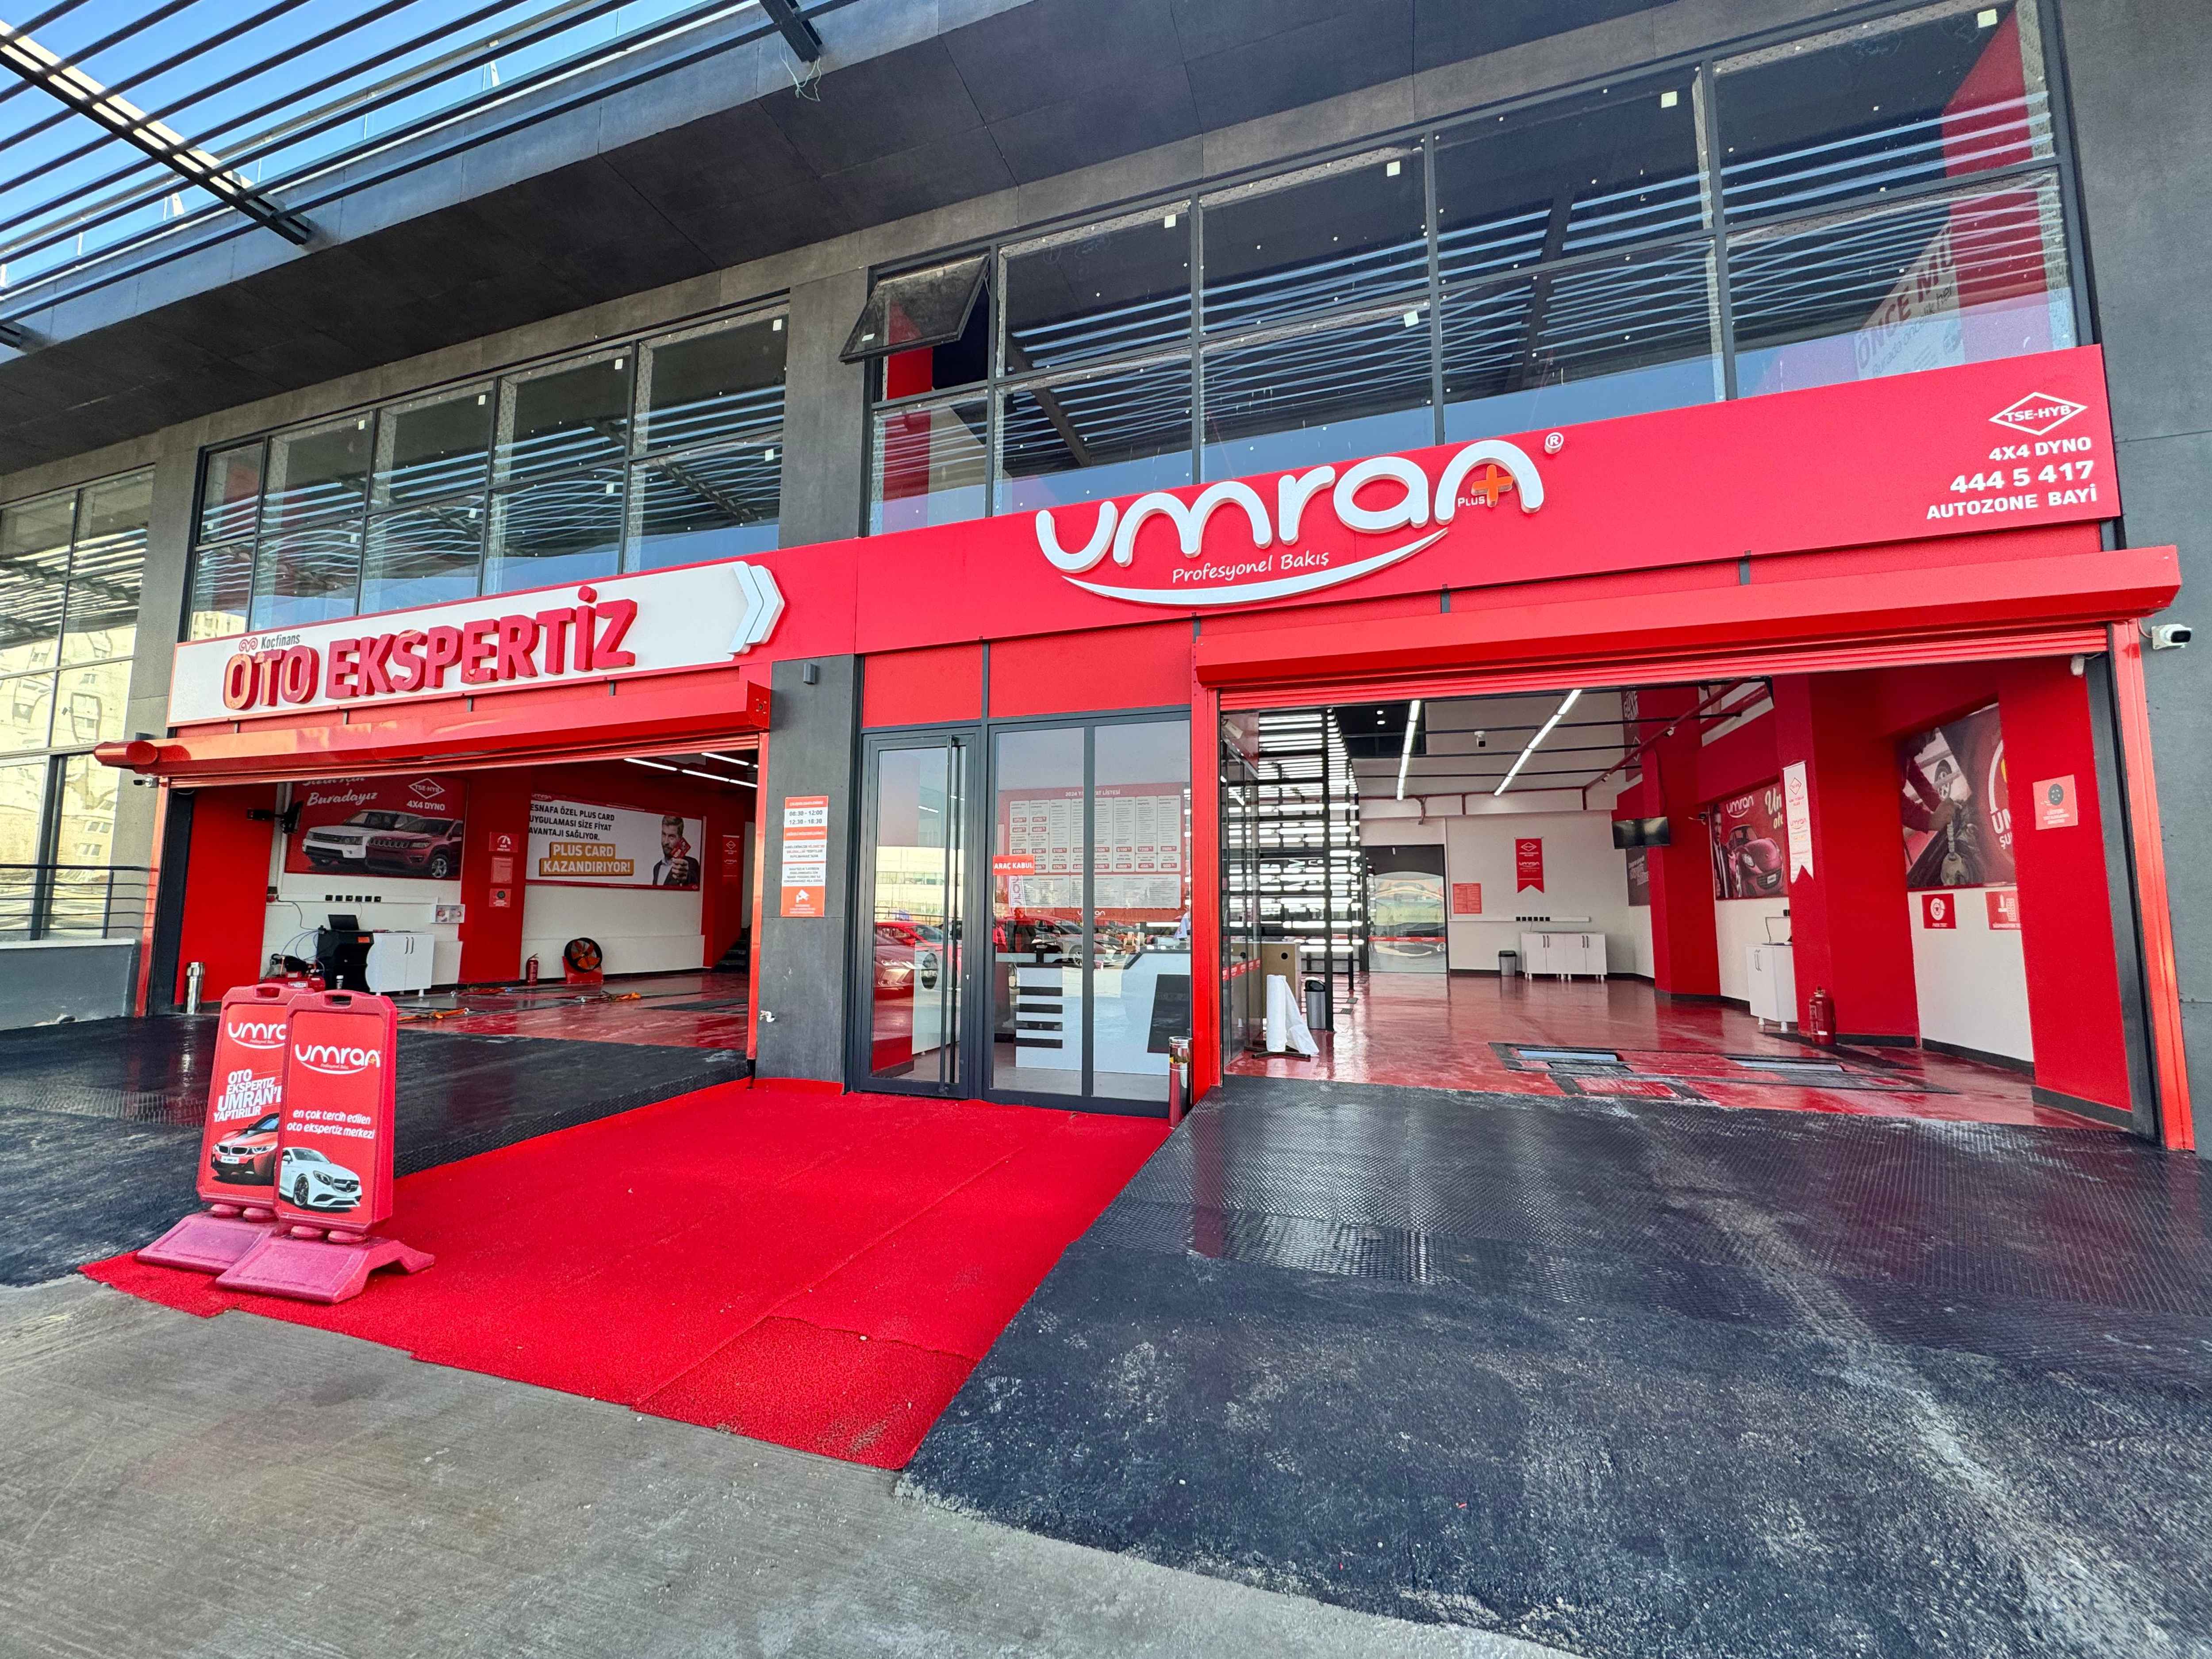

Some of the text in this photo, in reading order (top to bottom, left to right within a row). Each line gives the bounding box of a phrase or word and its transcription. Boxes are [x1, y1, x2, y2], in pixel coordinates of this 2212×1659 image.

[2005, 405, 2071, 422] TSE-HYB
[1989, 437, 2091, 461] 4X4 DYNO
[1950, 460, 2094, 493] 444 5 417
[1927, 484, 2097, 519] AUTOZONE BAYİ
[1173, 550, 1329, 583] Profesyonel Bakış
[223, 586, 638, 710] OTO EKSPERTİZ
[307, 789, 378, 806] Buradayız
[407, 800, 445, 811] 4X4 DYNO
[530, 804, 614, 821] ESNAFA ÖZEL PLUS CARD
[530, 815, 612, 831] UYGULAMASI SİZE FİYAT
[529, 827, 600, 841] AVANTAJI SAĞLIYOR.
[553, 844, 613, 857] PLUS CARD
[544, 860, 630, 872] KAZANDIRIYOR!
[994, 862, 1011, 871] ARAÇ
[295, 1044, 380, 1068] umran
[227, 1068, 252, 1084] OTO
[213, 1106, 261, 1122] YAPTIRILIR
[293, 1109, 371, 1125] en çok tercih edilen
[287, 1121, 376, 1140] oto ekspertiz merkezi
